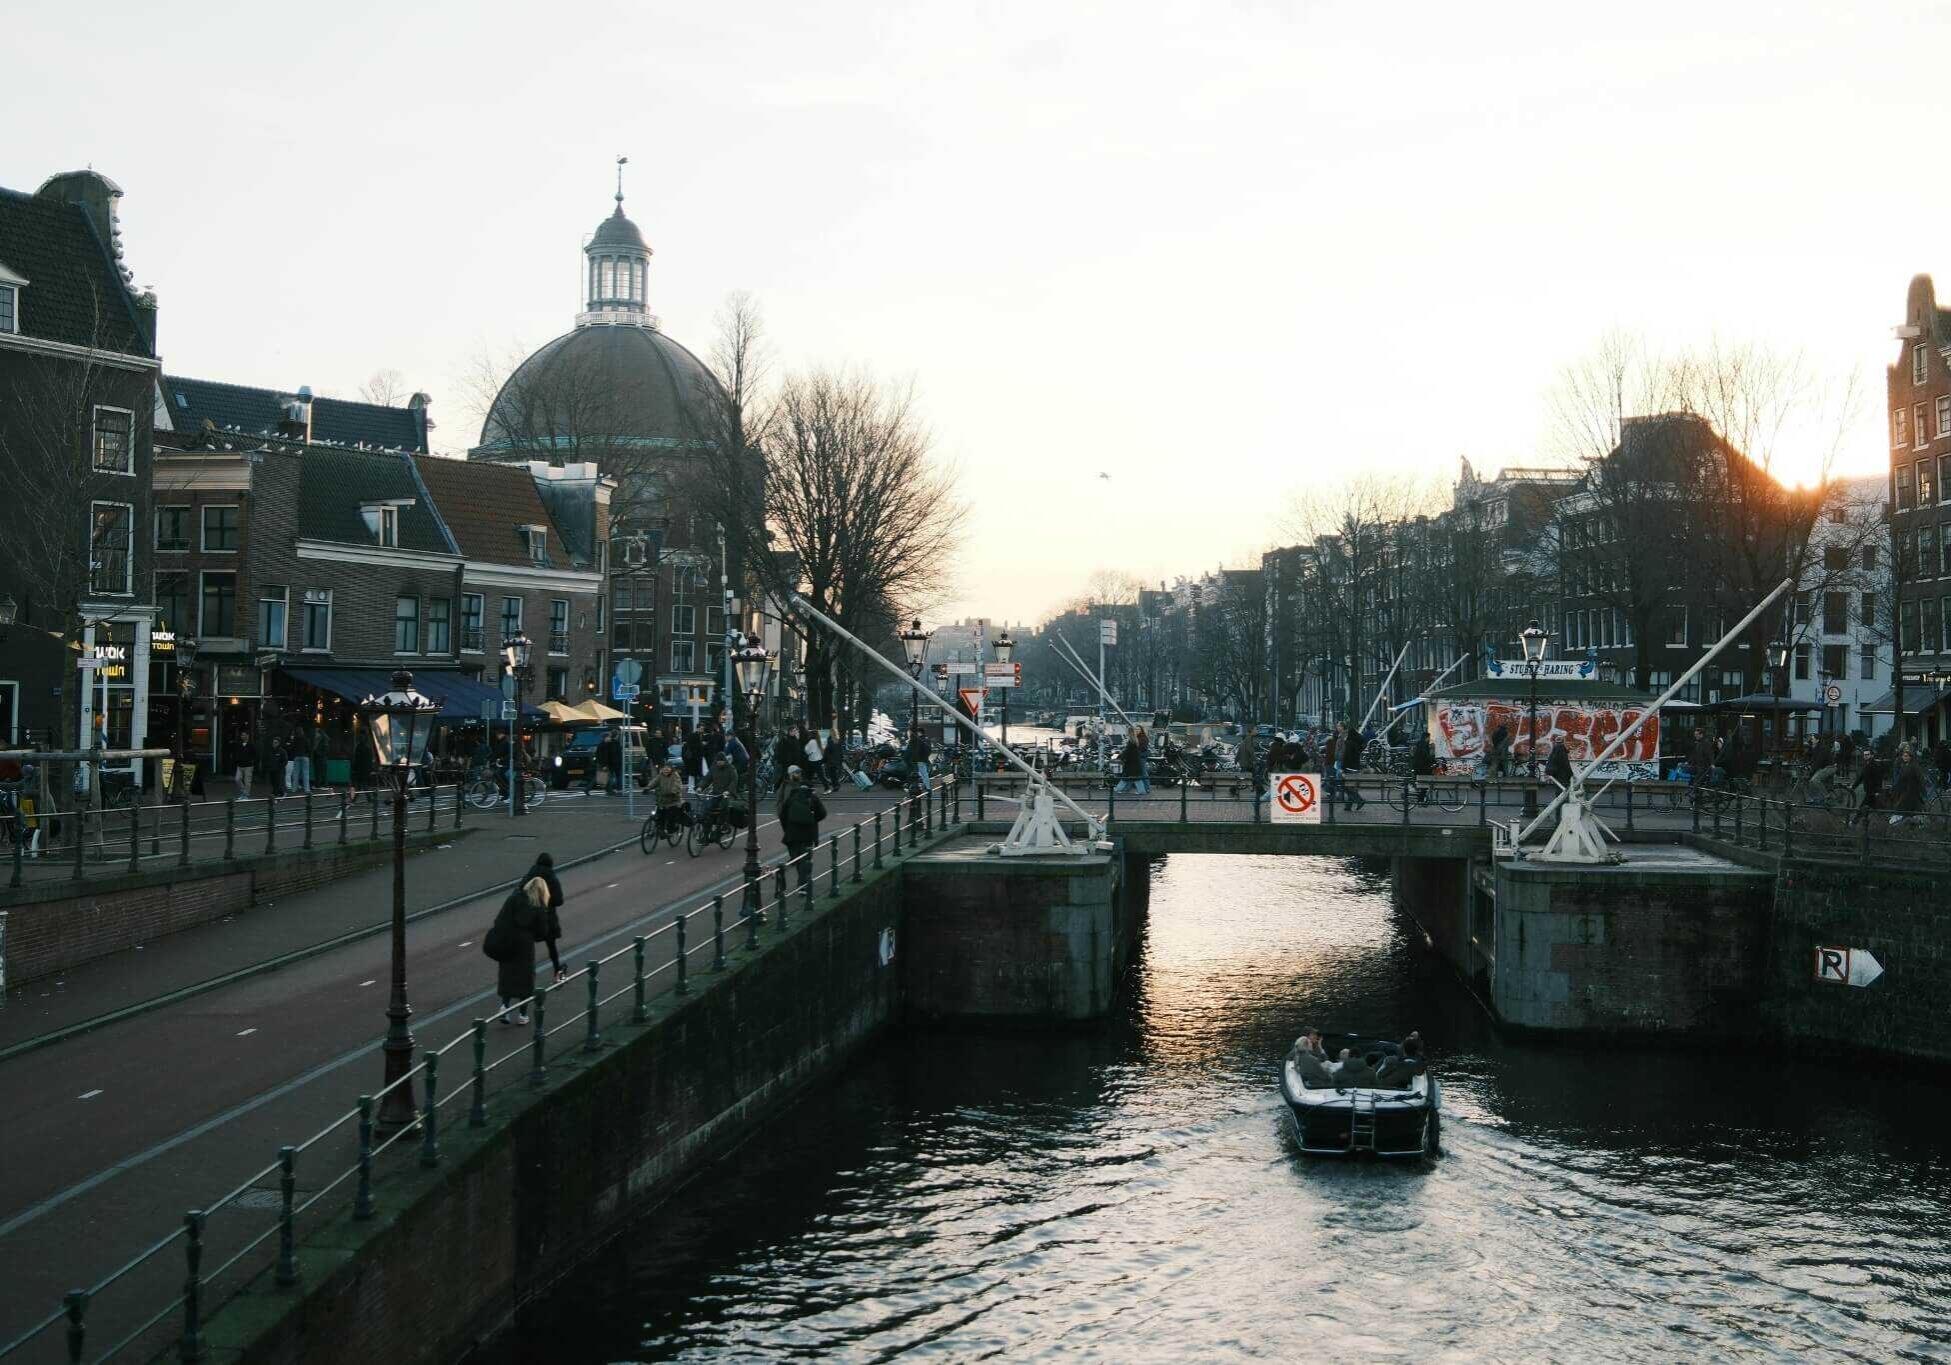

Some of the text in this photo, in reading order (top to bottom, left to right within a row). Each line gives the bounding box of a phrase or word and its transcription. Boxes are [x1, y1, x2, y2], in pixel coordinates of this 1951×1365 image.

[151, 631, 175, 641] WOK
[95, 646, 125, 659] WOK
[1544, 664, 1574, 675] HARING
